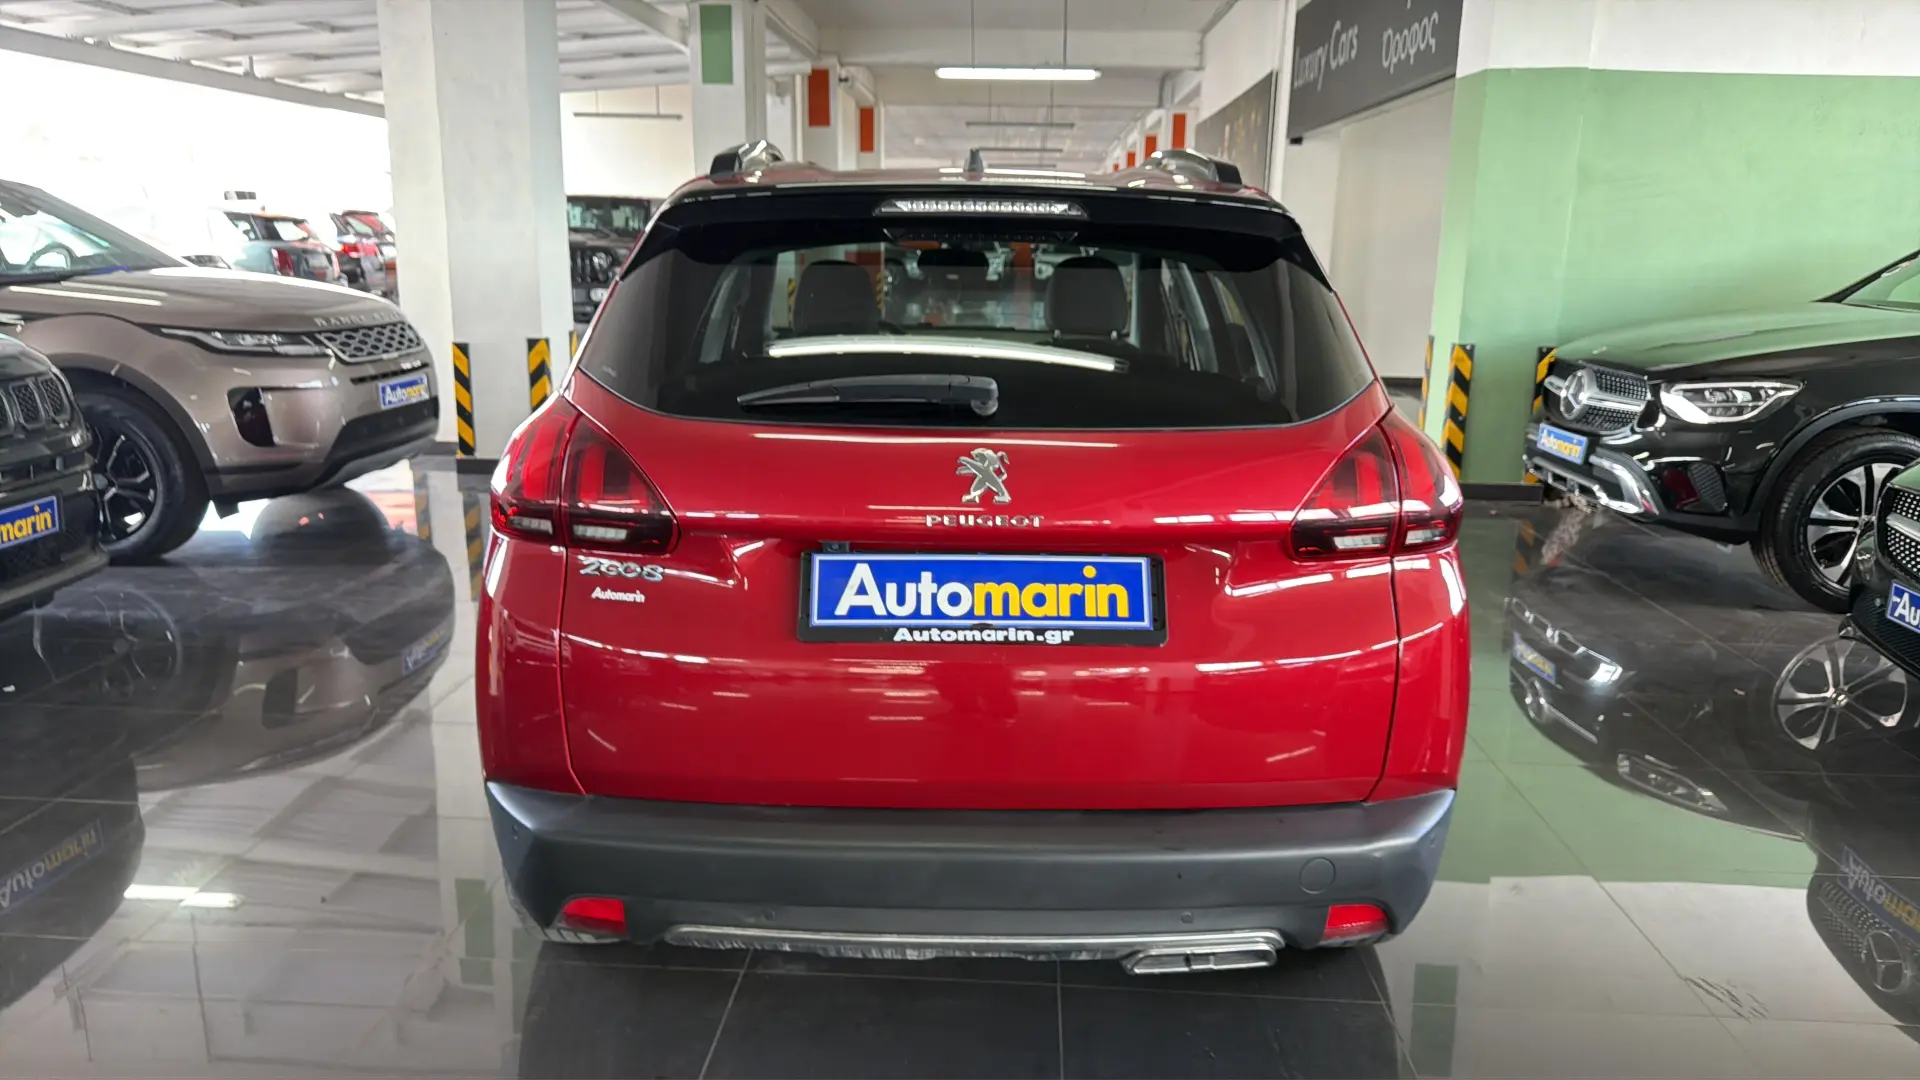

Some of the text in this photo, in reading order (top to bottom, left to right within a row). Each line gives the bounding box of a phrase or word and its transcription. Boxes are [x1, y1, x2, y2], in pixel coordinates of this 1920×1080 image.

[1294, 20, 1358, 92] Luxury Cars
[926, 514, 1044, 528] PEUGEOT
[591, 586, 645, 603] Automarin
[834, 562, 1130, 618] Automarin
[893, 626, 1075, 644] Automarin.gr
